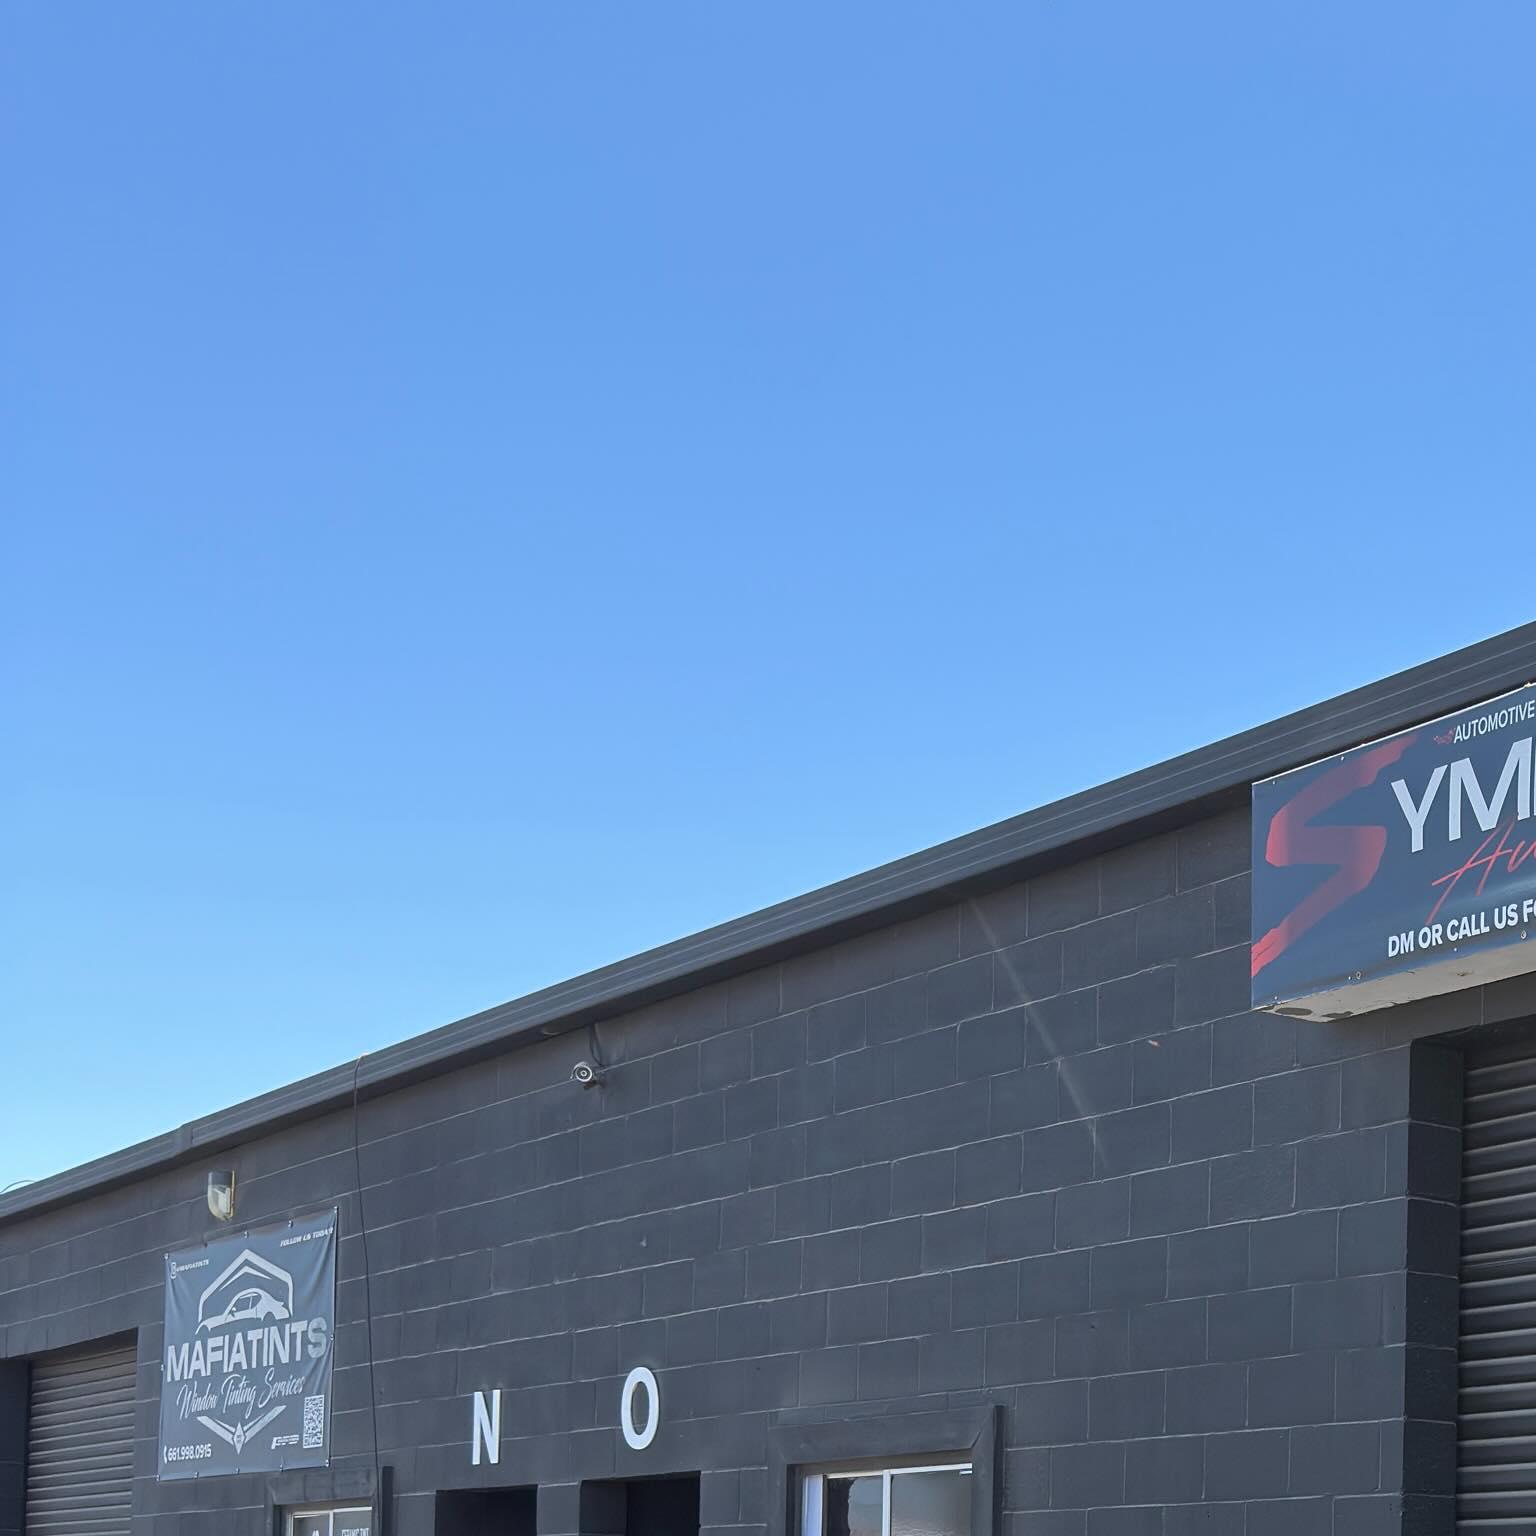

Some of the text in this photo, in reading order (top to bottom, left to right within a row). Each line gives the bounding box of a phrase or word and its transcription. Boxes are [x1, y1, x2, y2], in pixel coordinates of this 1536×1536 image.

[1453, 700, 1535, 744] AUTOMOTIVE
[1388, 931, 1414, 957] DM
[1418, 923, 1443, 949] OR
[1446, 916, 1490, 941] CALL
[1494, 903, 1518, 929] US
[167, 1316, 327, 1382] MAFIATINTS
[176, 1367, 305, 1419] Window Tinting Services
